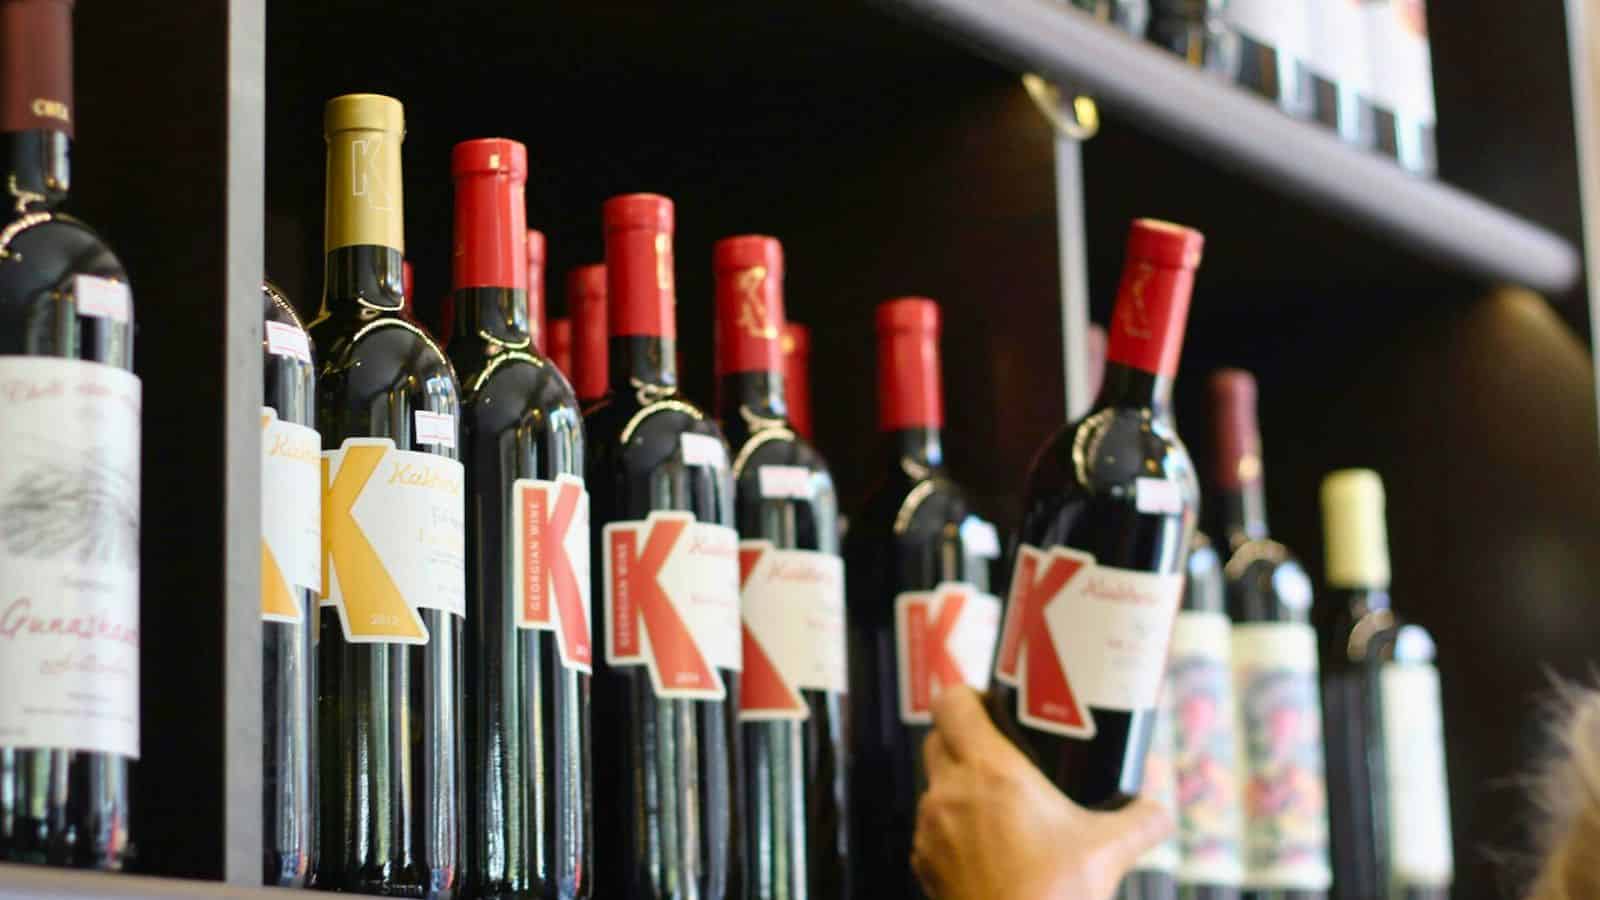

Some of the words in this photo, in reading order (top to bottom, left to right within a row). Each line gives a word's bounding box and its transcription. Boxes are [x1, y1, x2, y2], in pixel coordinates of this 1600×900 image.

[320, 445, 426, 638] K
[522, 483, 590, 666] K
[529, 502, 541, 536] WINE
[529, 541, 542, 612] GEORGIAN
[610, 519, 718, 691] K
[1000, 552, 1086, 728] K
